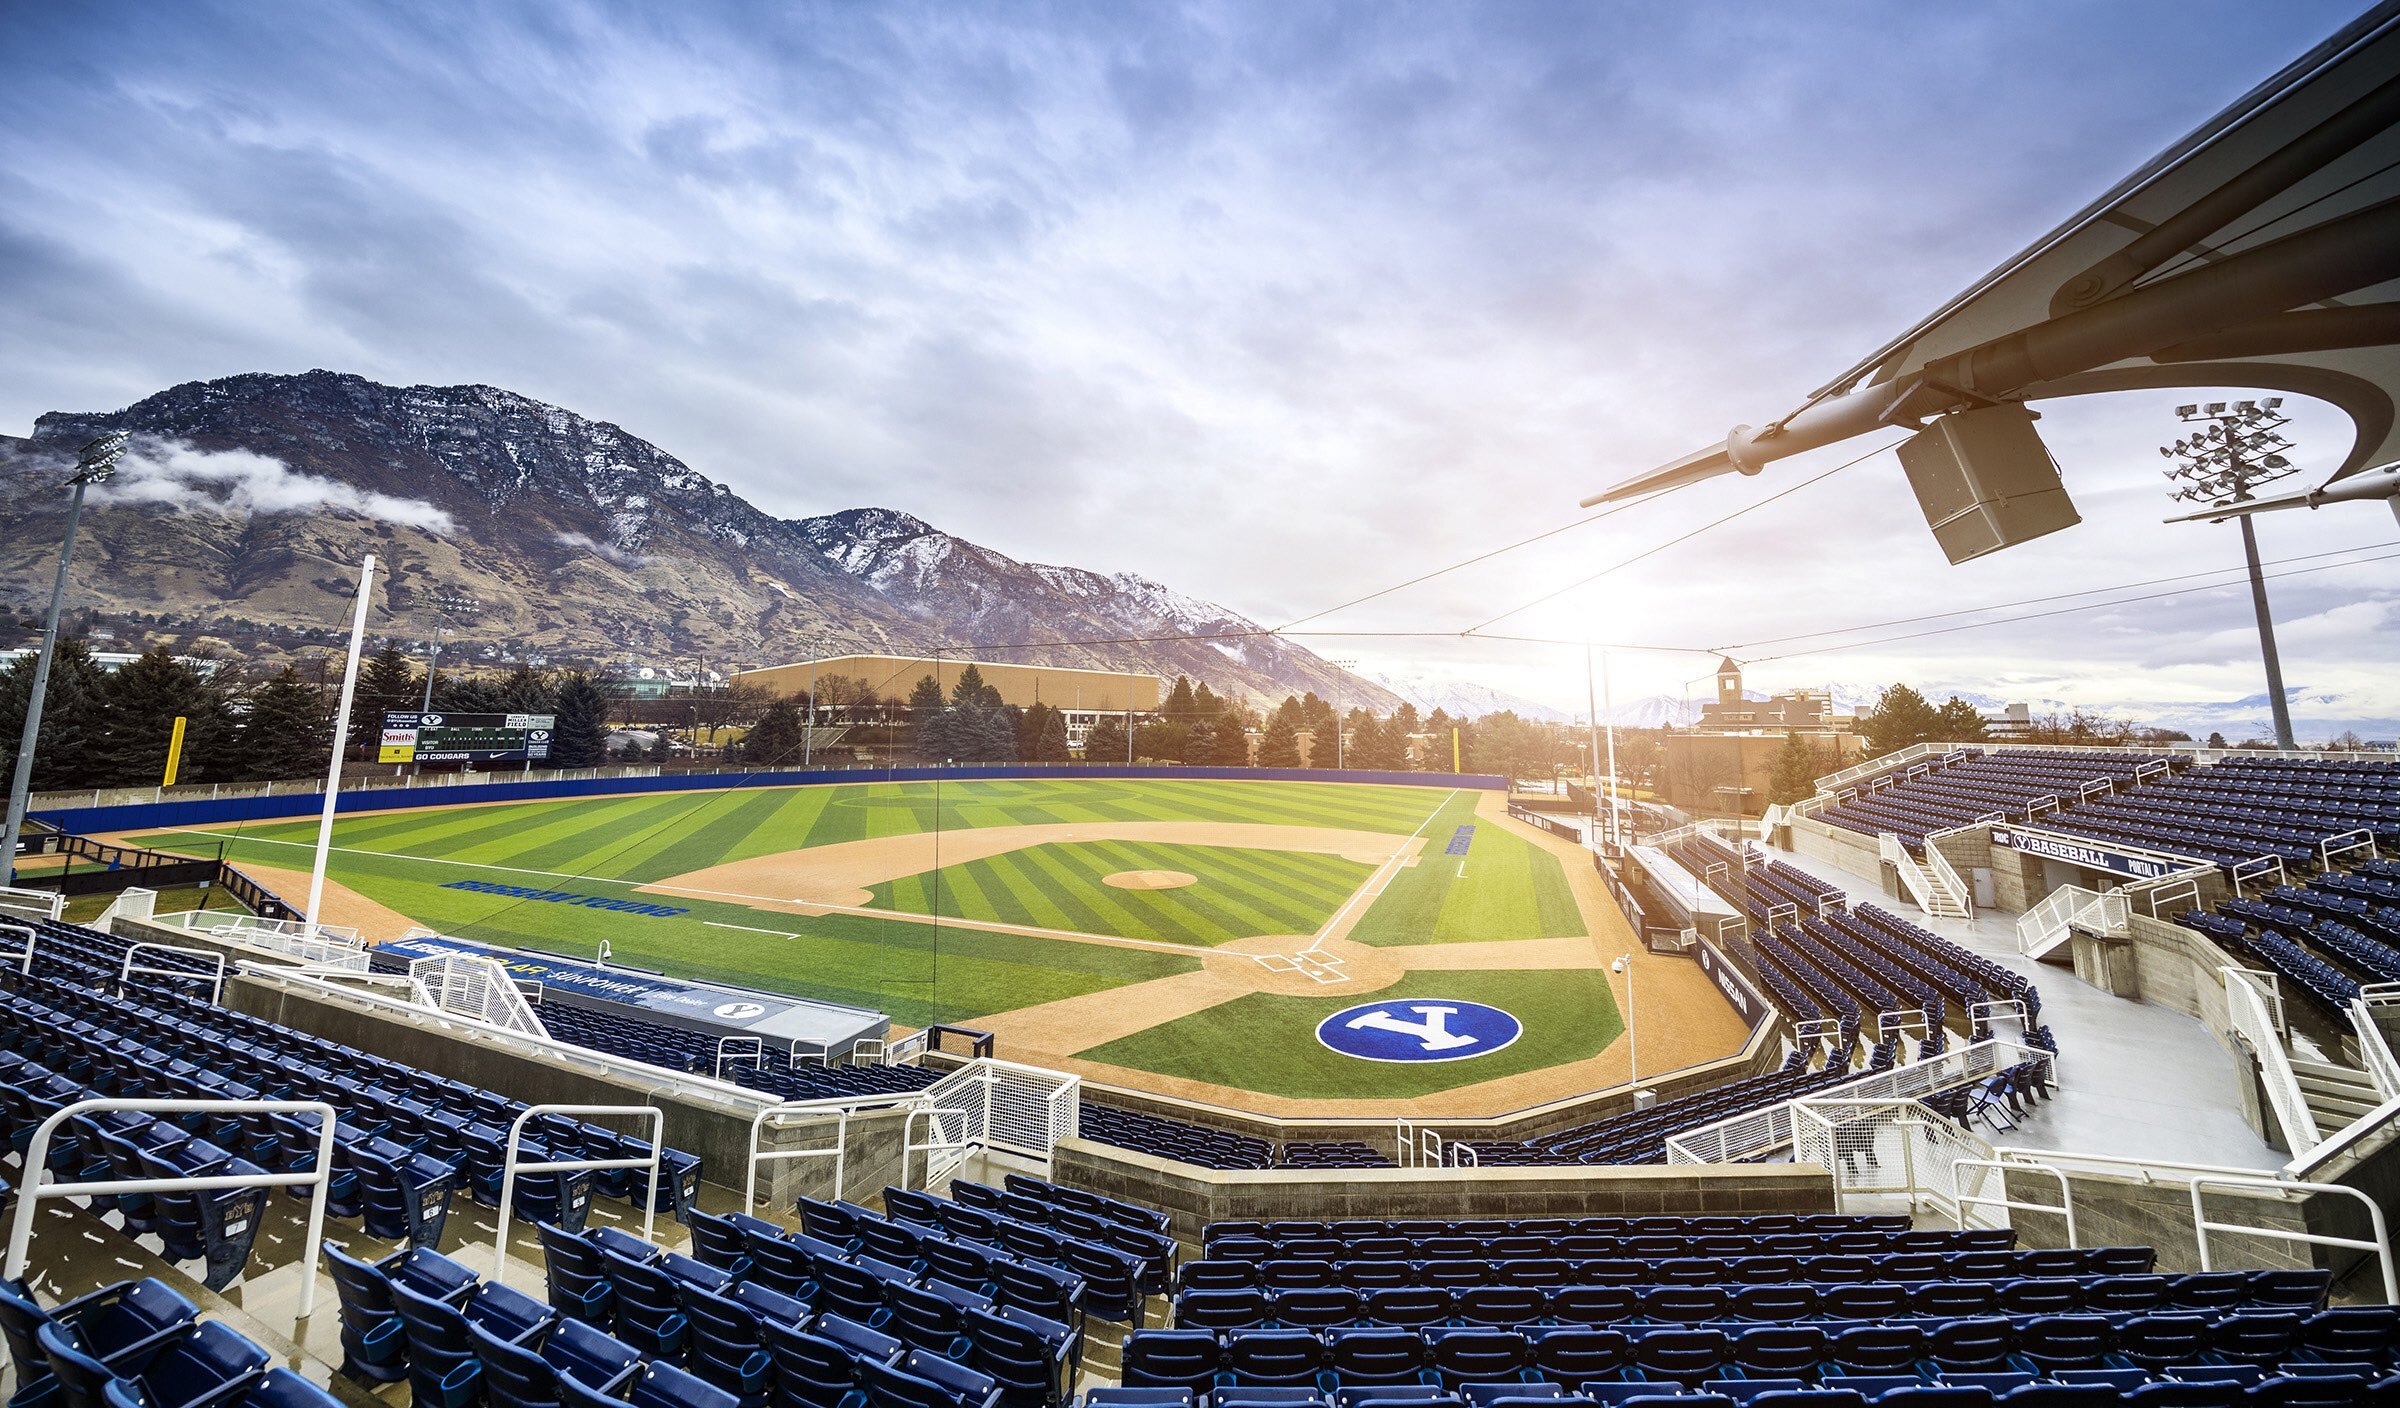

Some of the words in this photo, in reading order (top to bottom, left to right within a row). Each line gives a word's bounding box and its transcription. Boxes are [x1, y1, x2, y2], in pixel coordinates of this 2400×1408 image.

[382, 732, 415, 742] Smith's
[2030, 838, 2109, 868] BASEBALL
[2128, 859, 2154, 877] PORTAL
[1718, 968, 1748, 1015] NISSAN
[1345, 1006, 1480, 1050] Y
[224, 1202, 254, 1221] BYU
